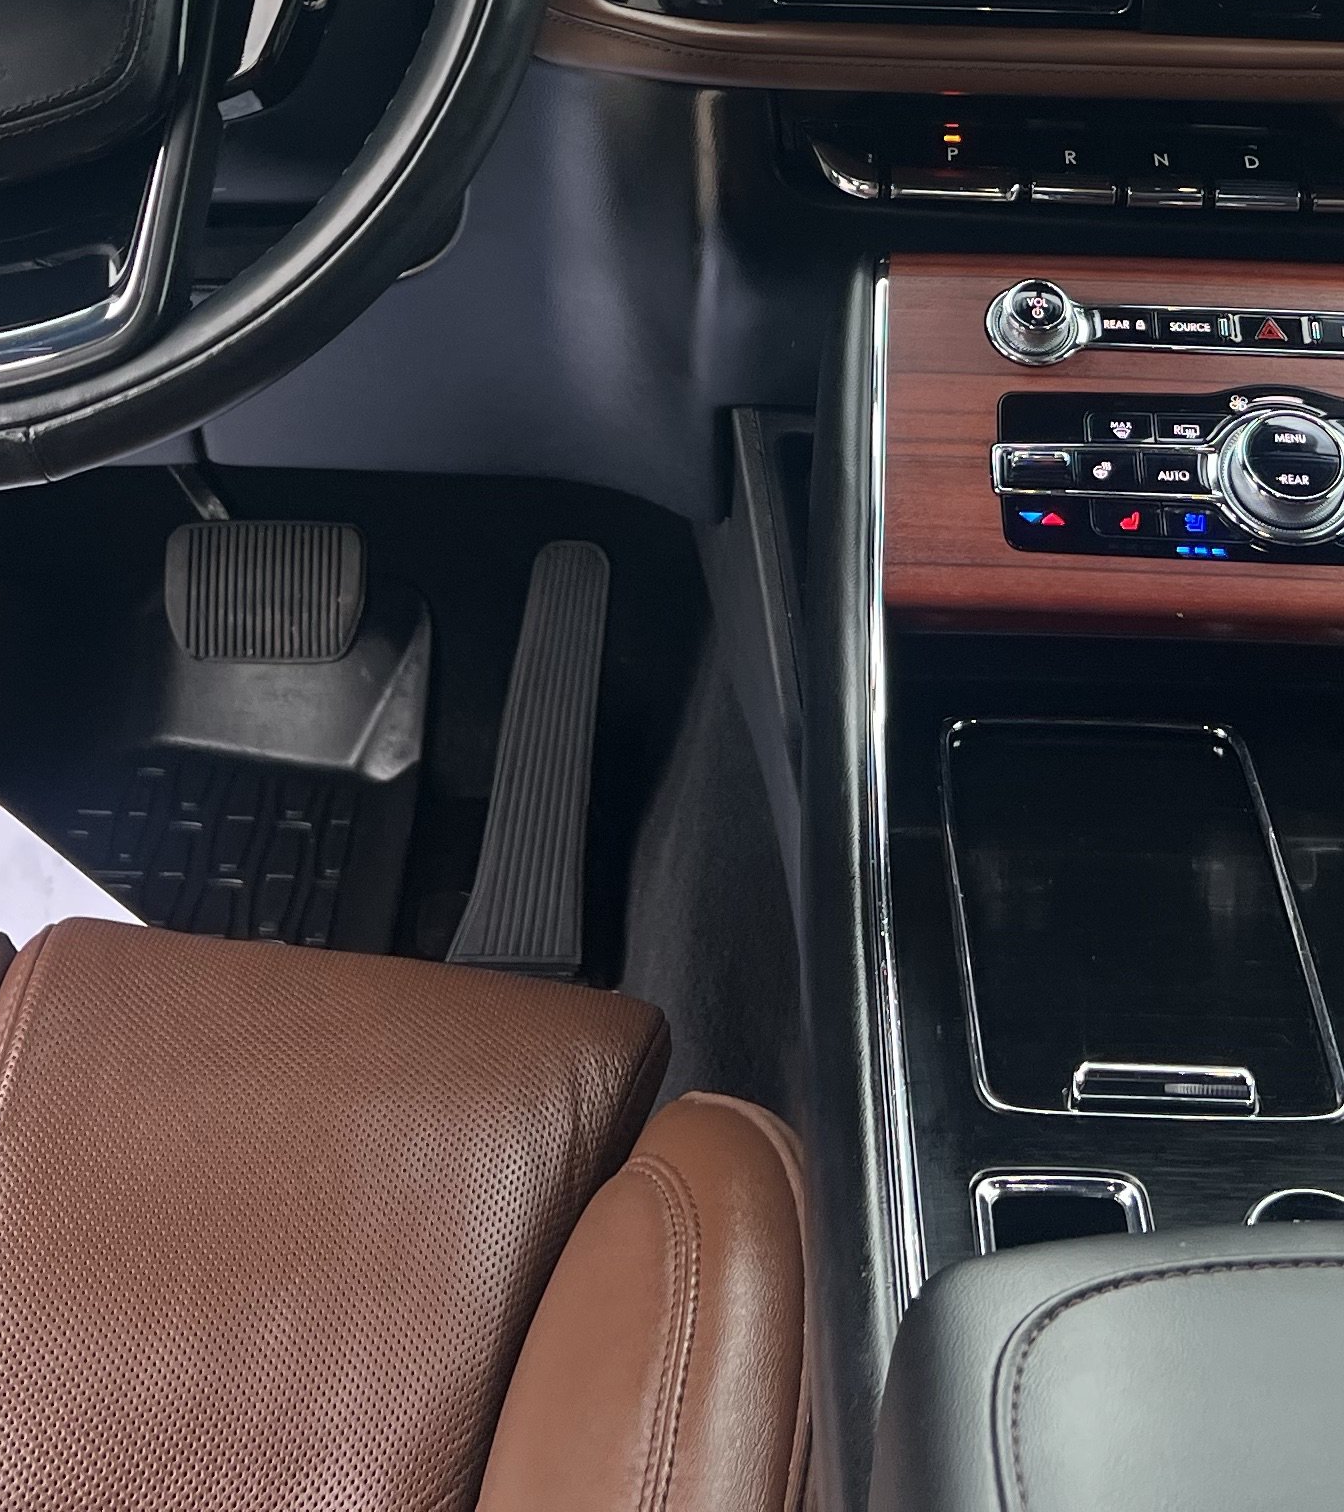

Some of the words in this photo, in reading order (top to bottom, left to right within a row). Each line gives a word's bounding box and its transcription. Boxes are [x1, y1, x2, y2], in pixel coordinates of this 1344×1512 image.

[947, 147, 959, 161] P
[1064, 150, 1077, 165] R
[1153, 153, 1170, 167] N
[1244, 155, 1260, 170] D
[1026, 297, 1048, 308] VOL
[1103, 319, 1130, 330] REAR
[1169, 321, 1211, 333] SOURCE
[1110, 421, 1132, 429] MAX
[1274, 433, 1307, 444] MENU
[1158, 470, 1190, 481] AUTO
[1280, 473, 1310, 485] REAR
